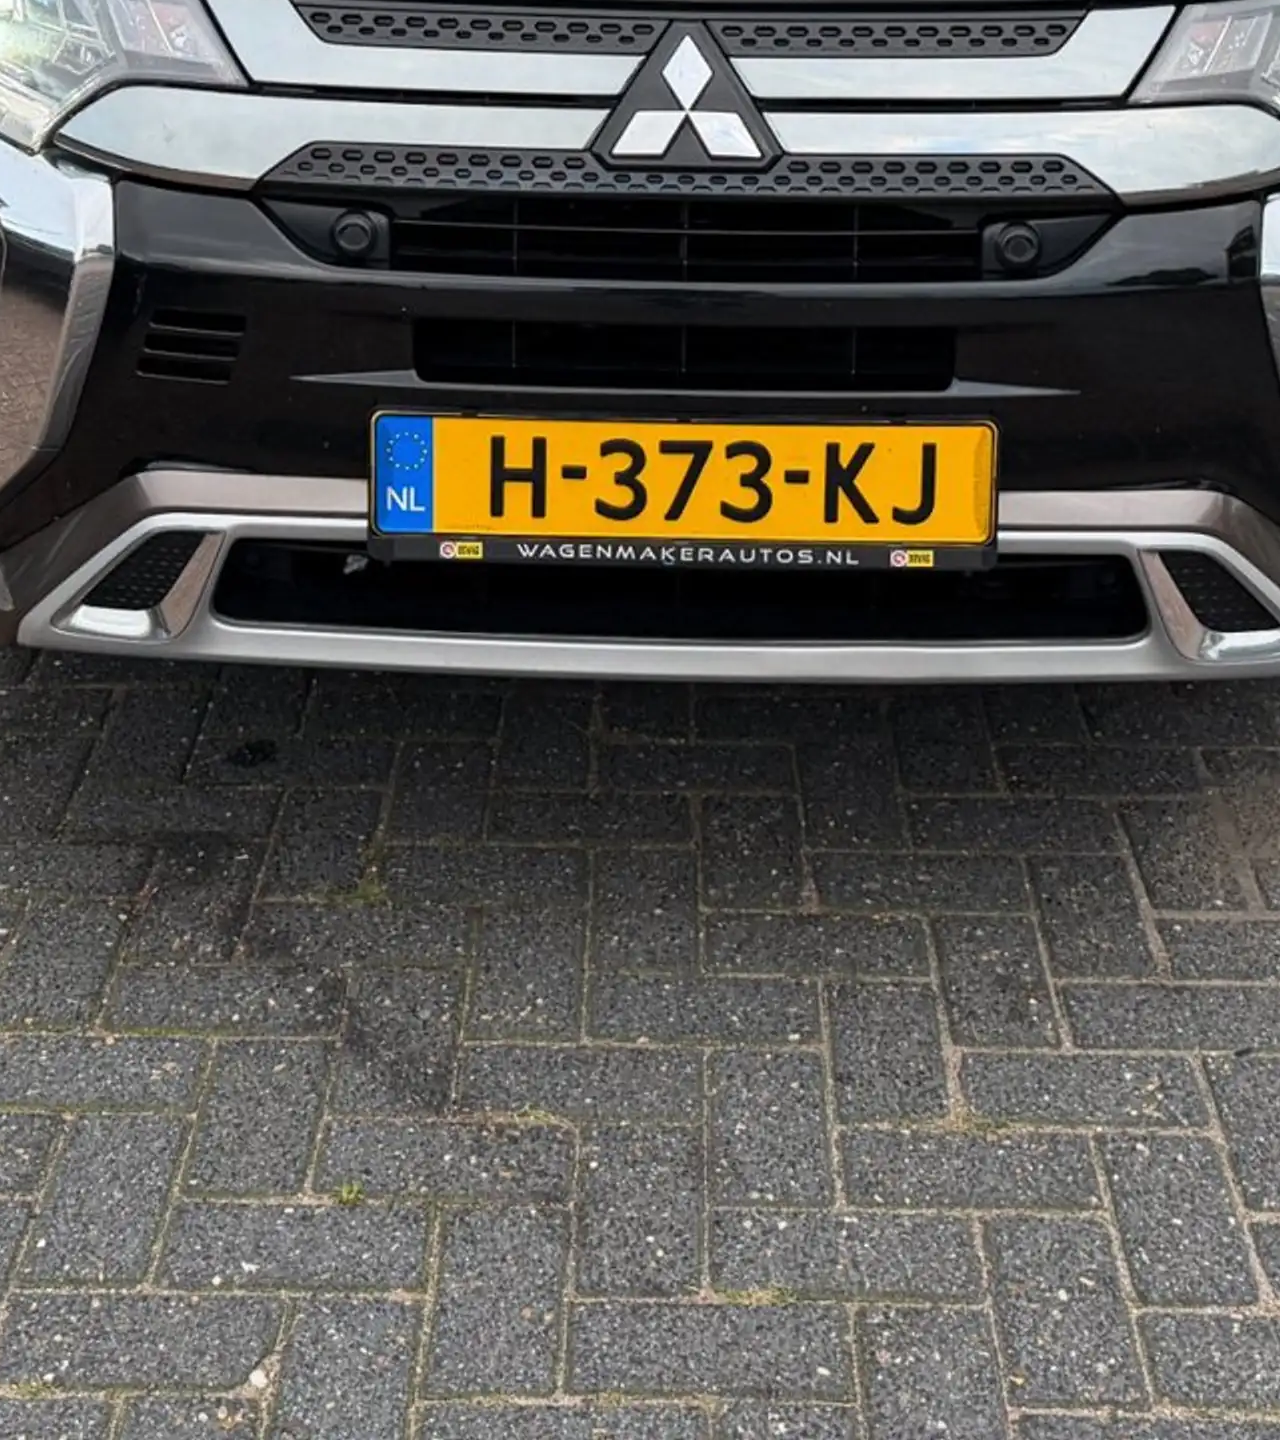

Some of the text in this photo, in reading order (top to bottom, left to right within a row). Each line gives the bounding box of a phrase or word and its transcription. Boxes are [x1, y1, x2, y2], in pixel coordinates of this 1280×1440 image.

[490, 435, 937, 526] H-373-KJ
[386, 485, 427, 512] NL
[516, 543, 860, 566] WAGENMAKERAUTOS.NL
